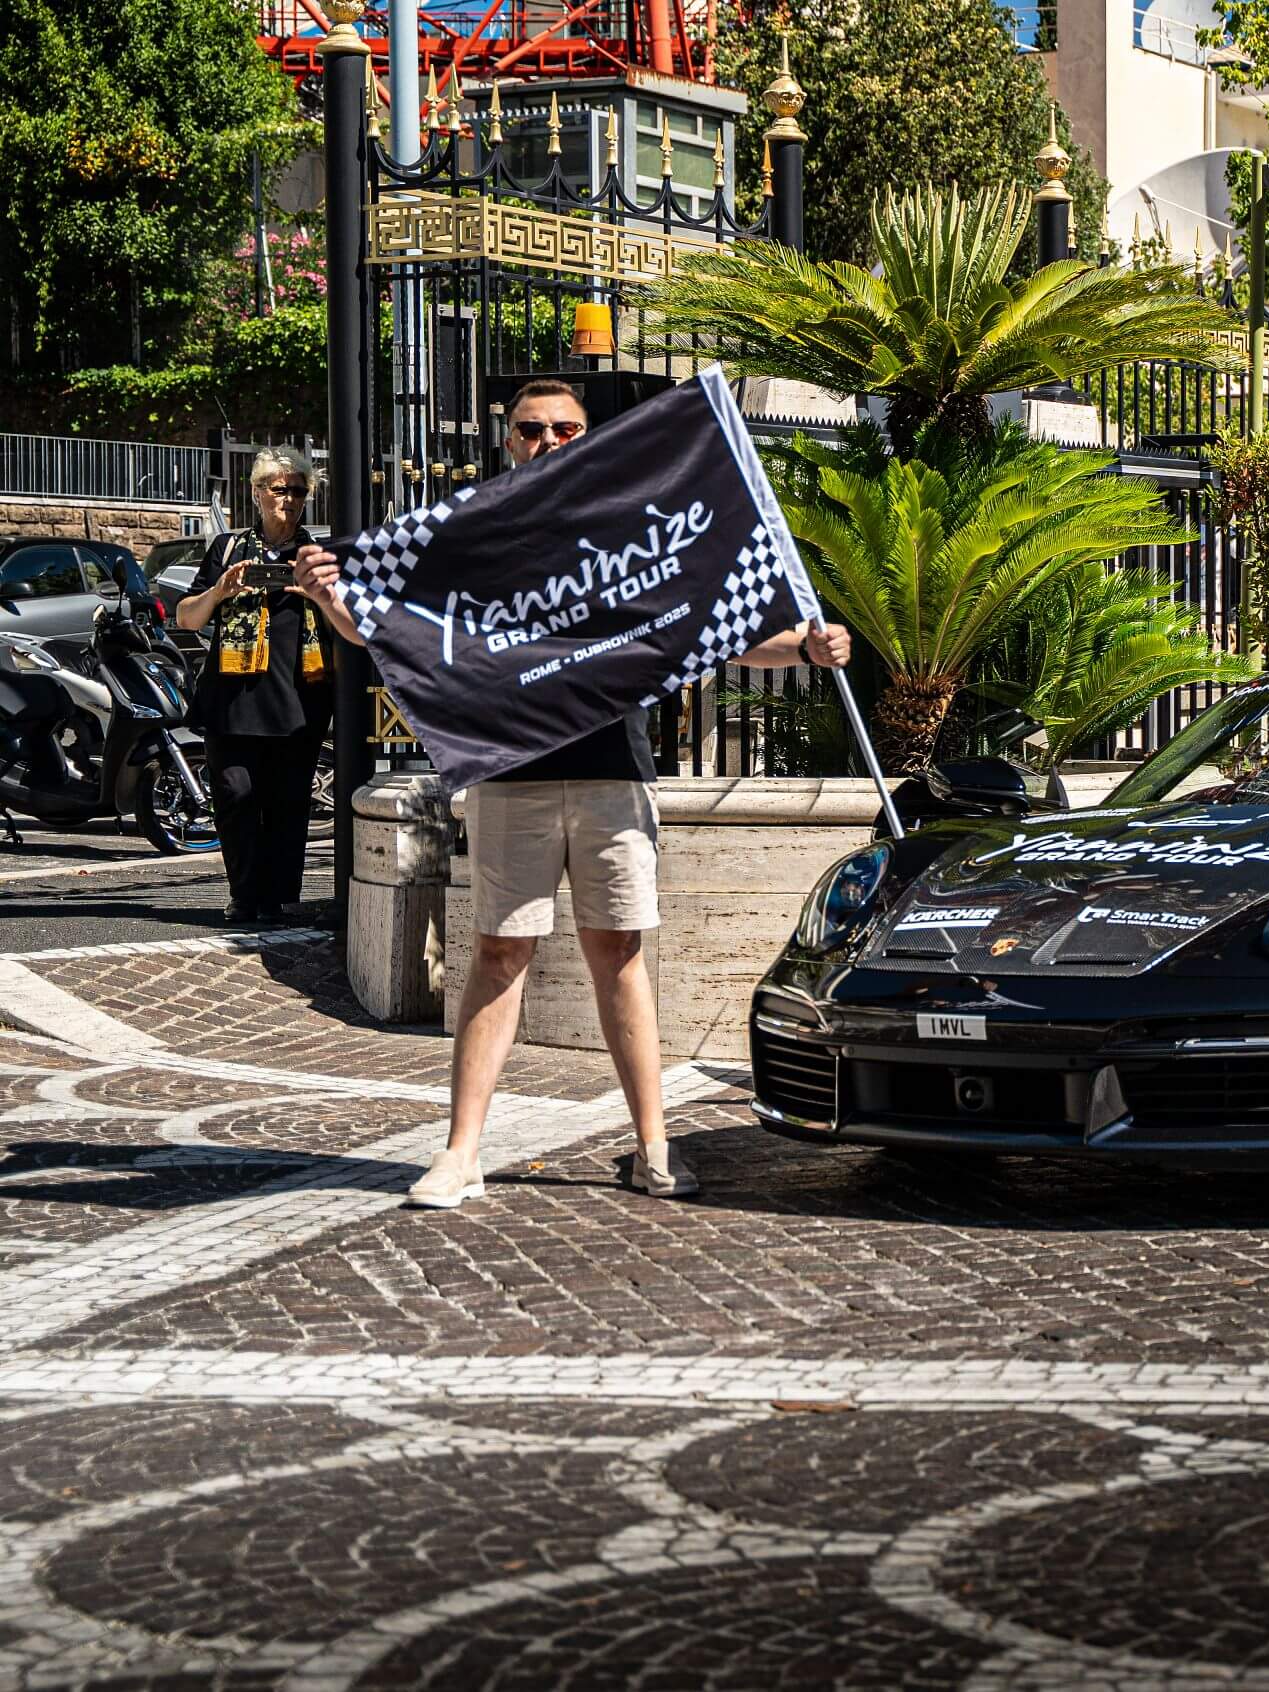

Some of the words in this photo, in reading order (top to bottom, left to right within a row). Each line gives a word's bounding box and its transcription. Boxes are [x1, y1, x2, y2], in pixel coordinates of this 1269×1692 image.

[404, 500, 714, 667] Yiannimize
[486, 601, 591, 653] GRAND
[599, 555, 683, 609] TOUR
[519, 658, 562, 686] ROME
[573, 622, 652, 663] DUBROVNIK
[653, 602, 692, 631] 2025
[1014, 851, 1137, 862] GRAND
[1146, 852, 1245, 867] TOUR
[939, 1018, 972, 1037] MVL
